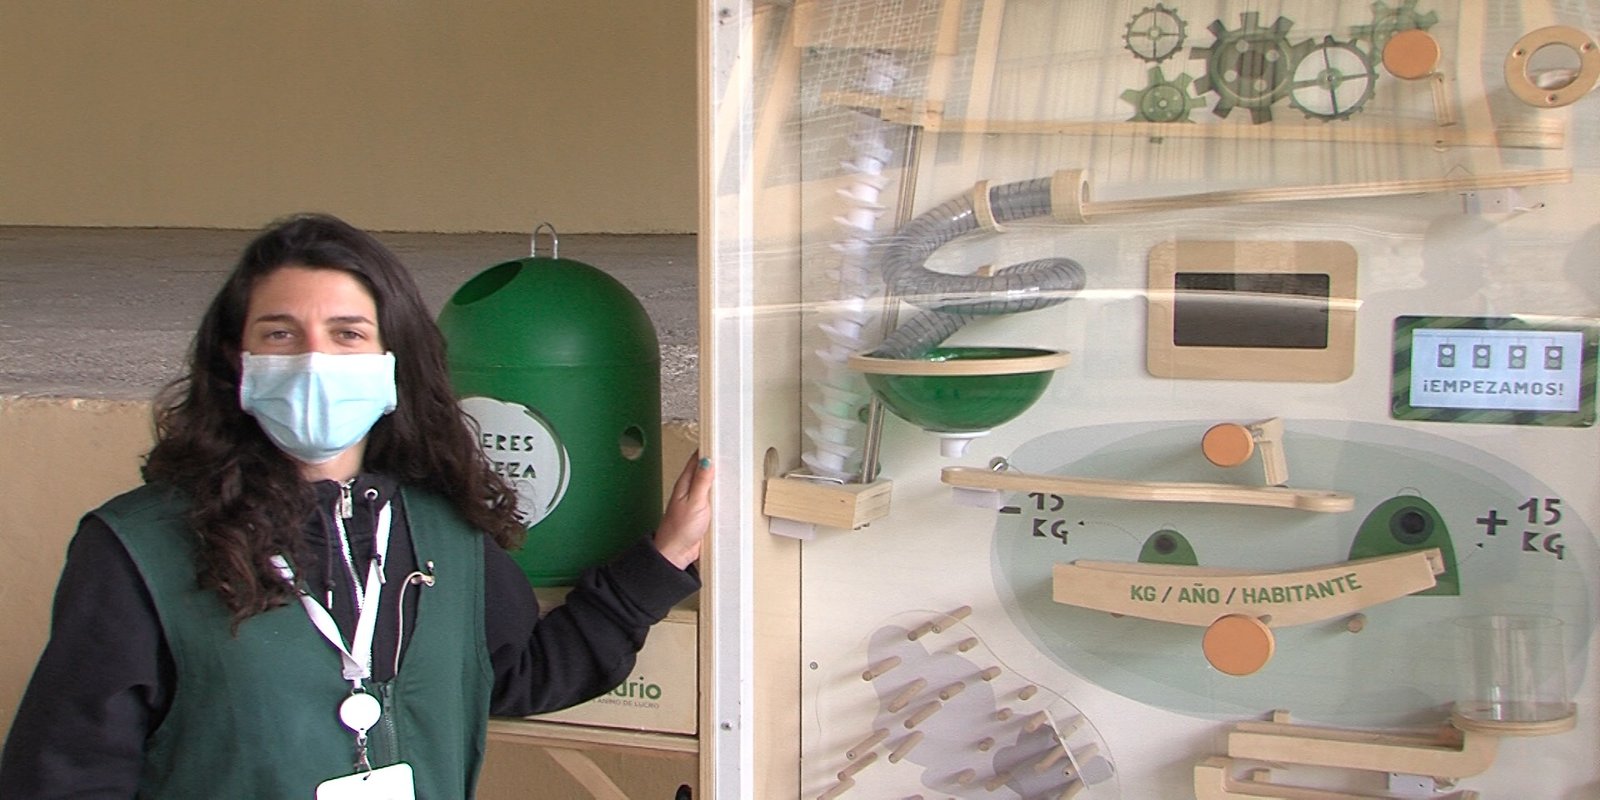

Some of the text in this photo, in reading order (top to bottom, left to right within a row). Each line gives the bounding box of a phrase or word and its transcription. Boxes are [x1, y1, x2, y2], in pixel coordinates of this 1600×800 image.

[1423, 379, 1564, 396] ¡EMPEZAMOS!
[493, 461, 537, 479] EZA
[1517, 497, 1562, 526] 15
[1032, 517, 1069, 545] KG
[1522, 531, 1565, 560] KG
[1130, 584, 1157, 602] KG
[1178, 582, 1220, 604] AÑO
[1241, 572, 1363, 604] HABITANTE
